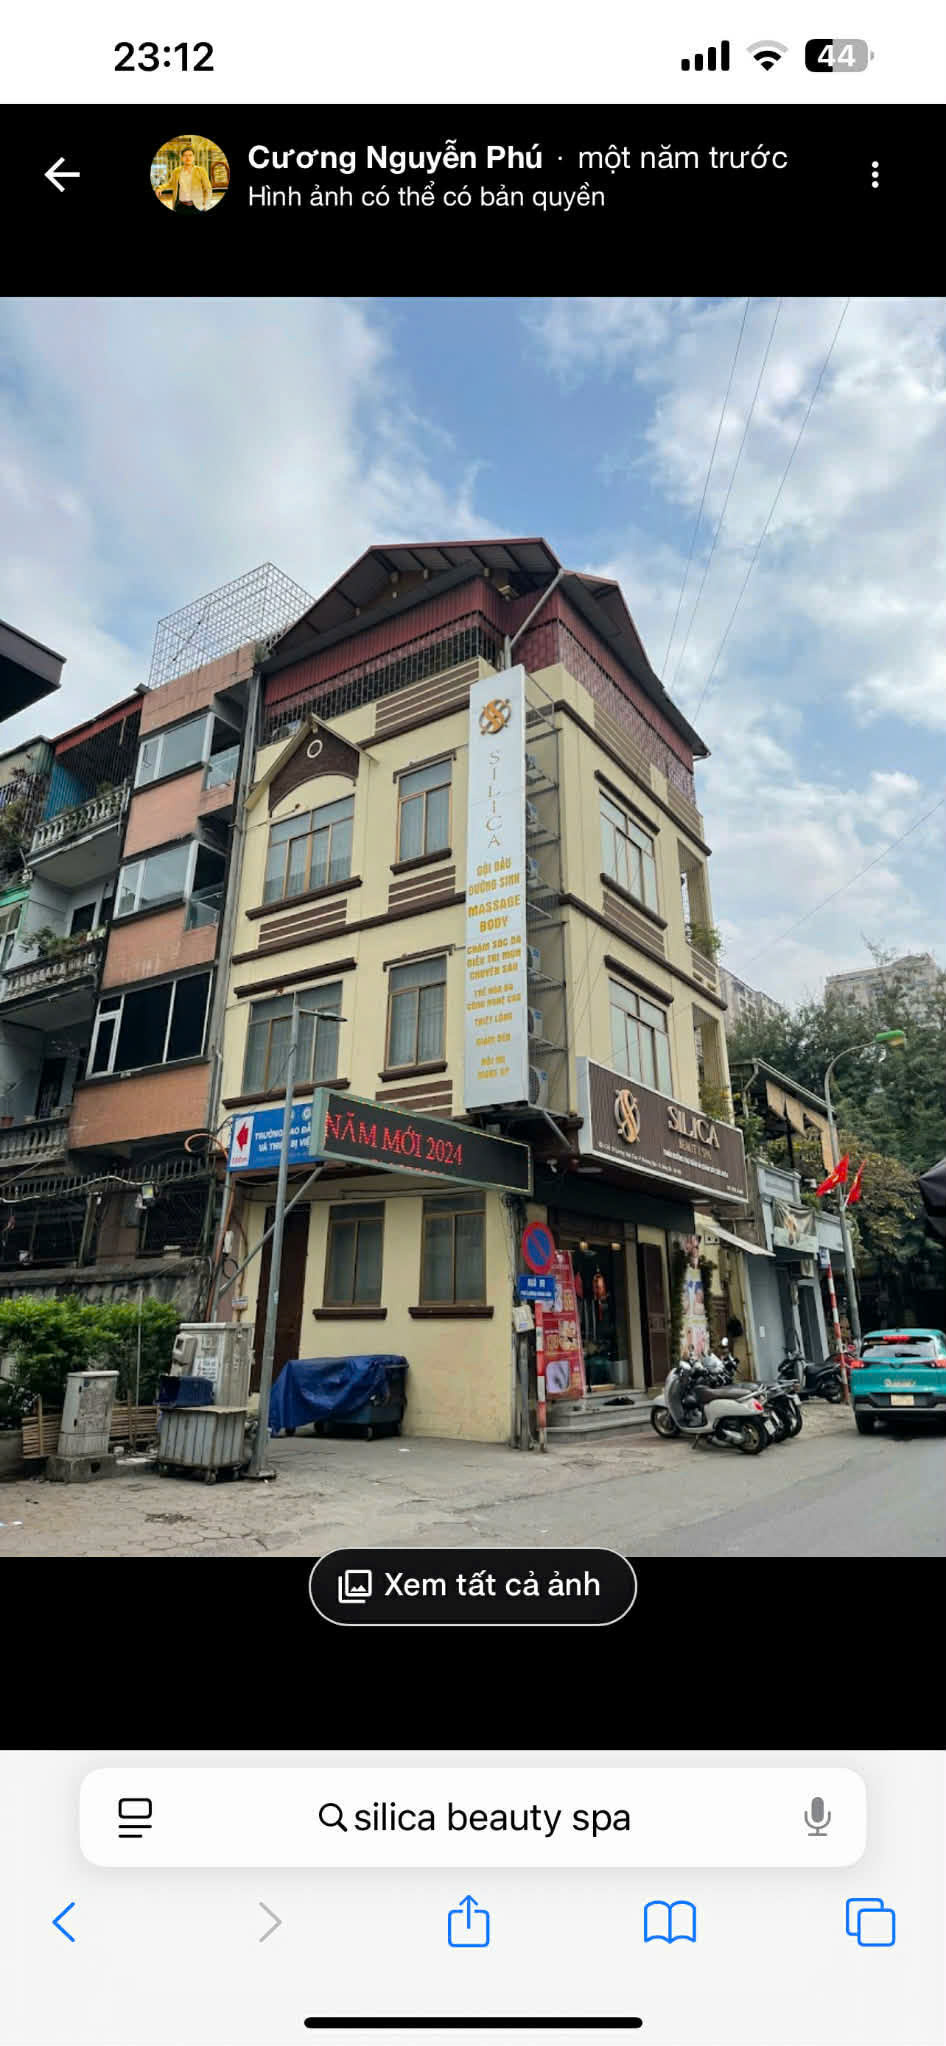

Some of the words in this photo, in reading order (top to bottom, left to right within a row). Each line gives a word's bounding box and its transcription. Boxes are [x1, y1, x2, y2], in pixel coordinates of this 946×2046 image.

[486, 752, 503, 849] SILICA
[499, 872, 520, 888] SINH
[468, 894, 521, 917] MASSAGE
[480, 915, 509, 933] BODY
[325, 1112, 377, 1148] NĂM
[382, 1125, 422, 1158] MỚI
[426, 1137, 463, 1165] 2024
[667, 1106, 720, 1149] SILICA
